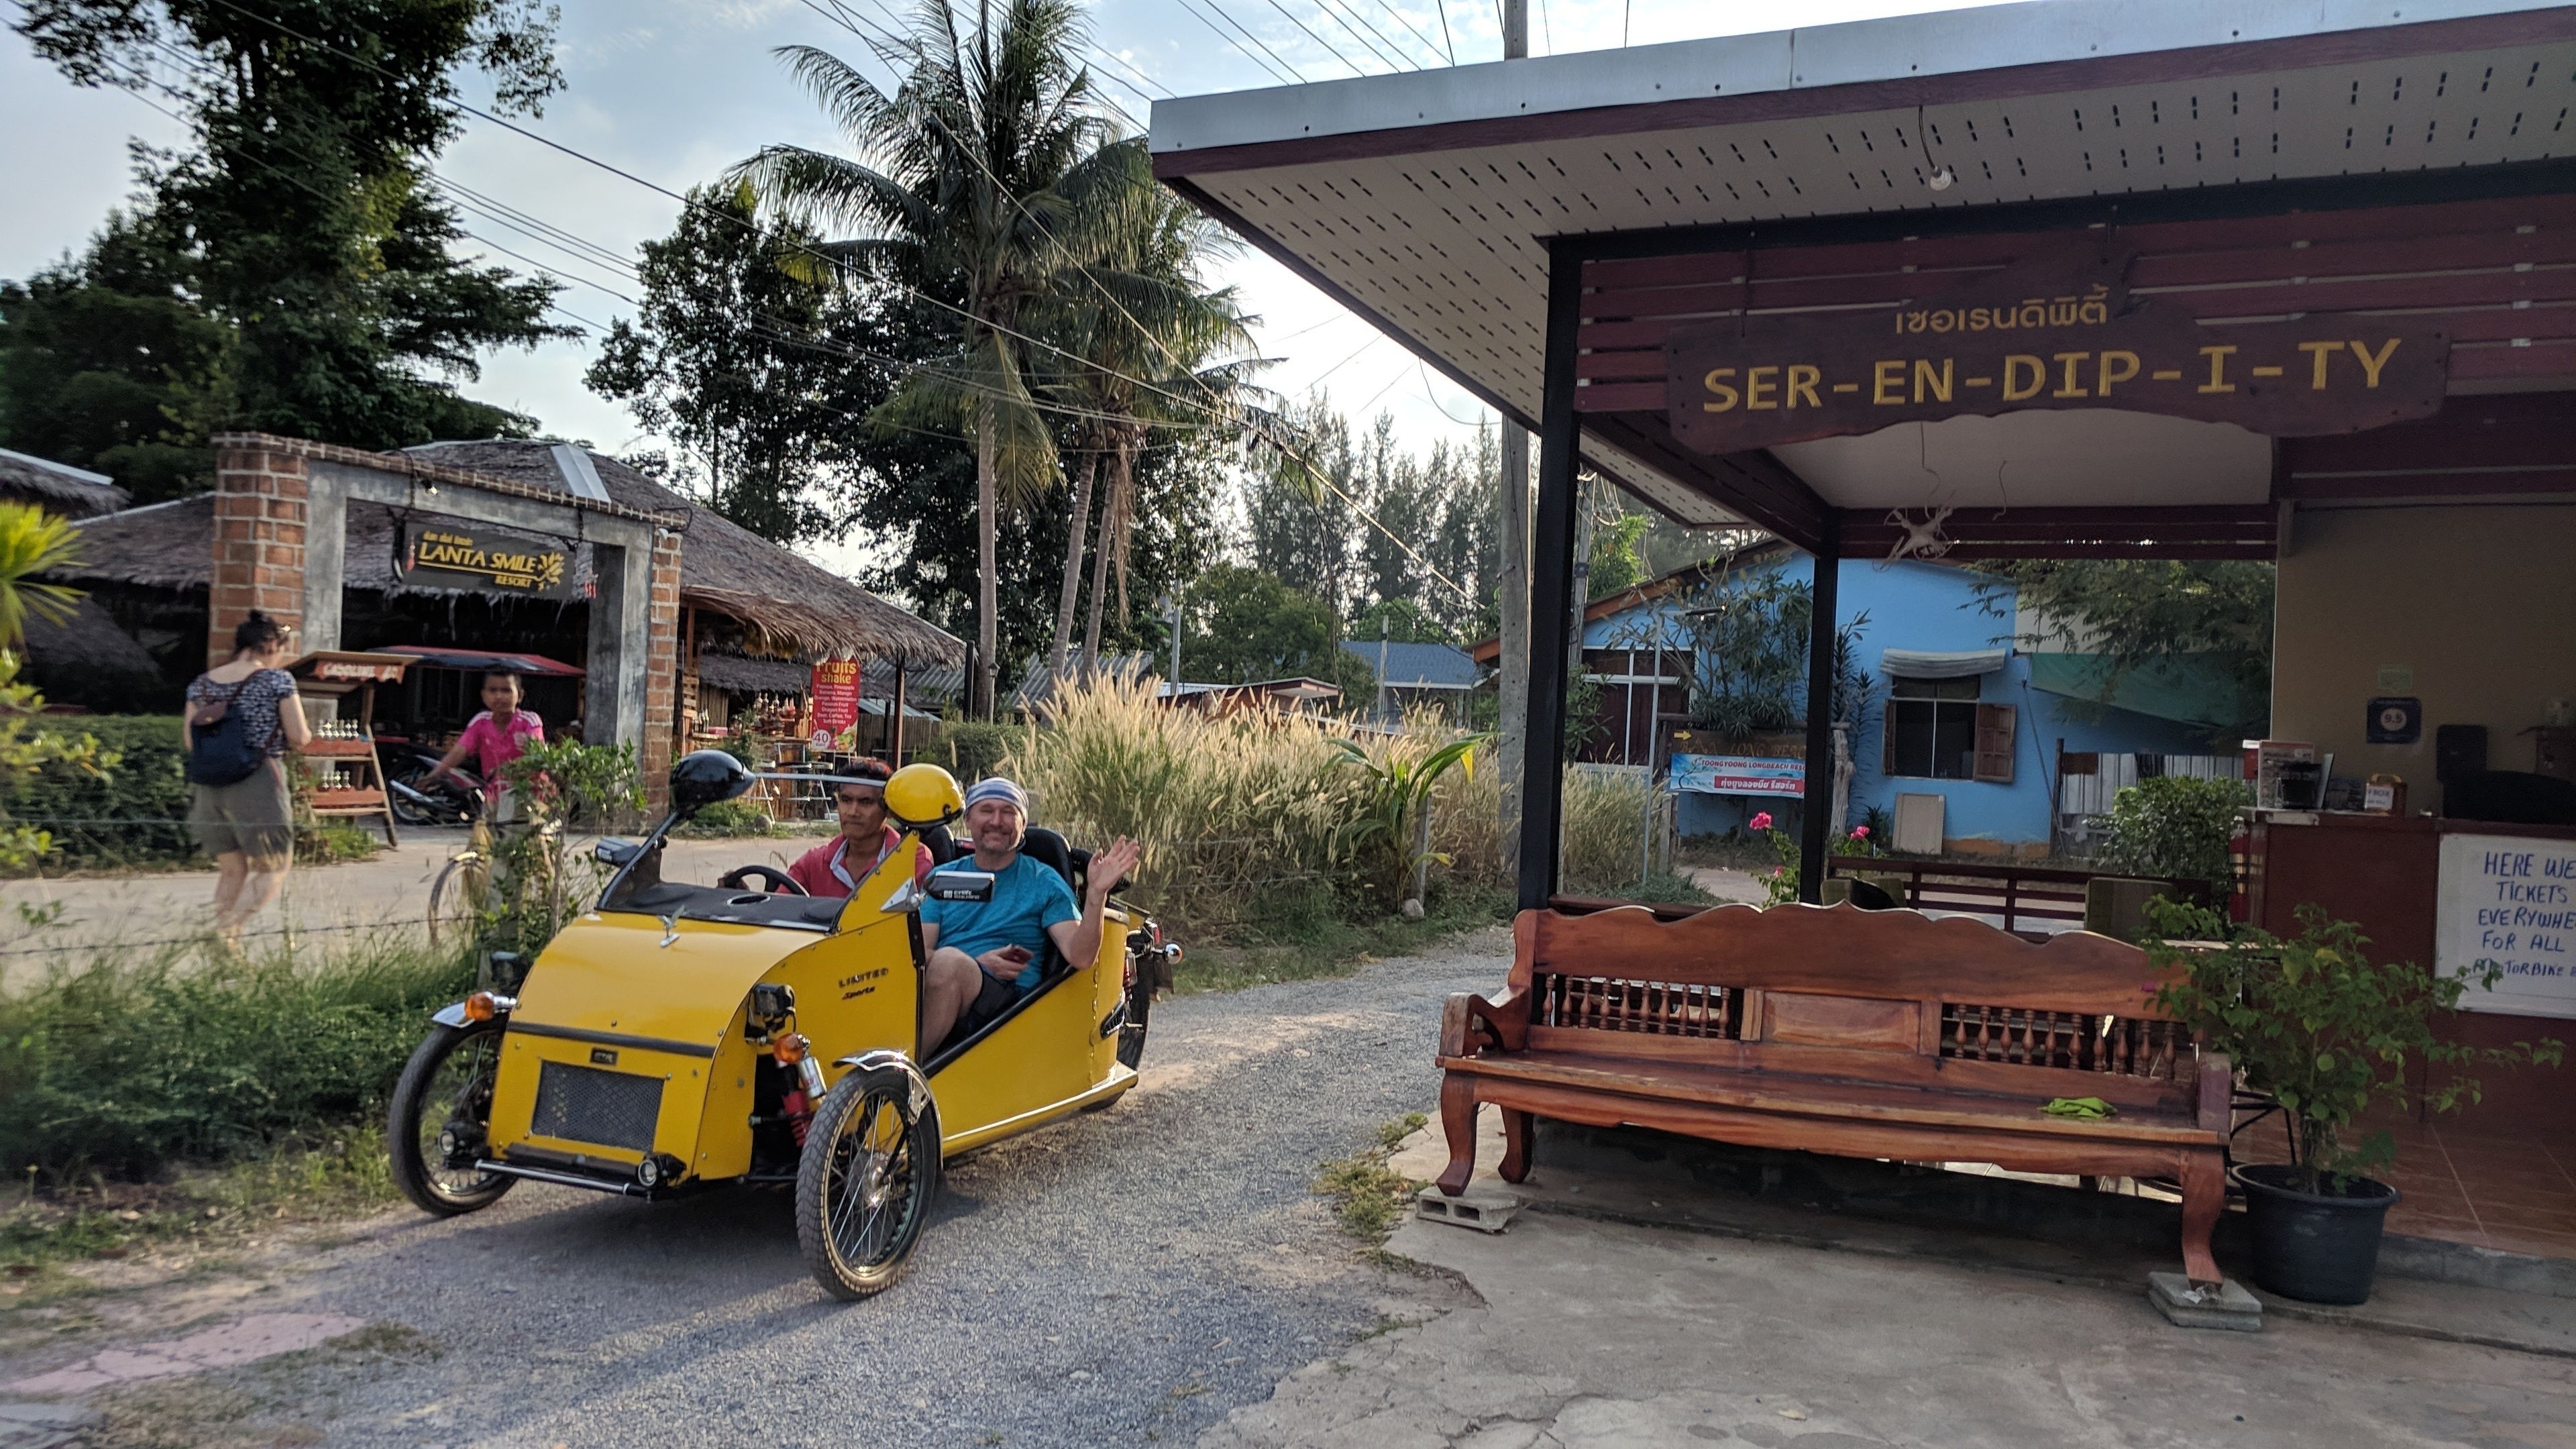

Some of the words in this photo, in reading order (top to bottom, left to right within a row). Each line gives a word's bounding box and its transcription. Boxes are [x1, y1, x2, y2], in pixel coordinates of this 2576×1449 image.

[419, 541, 486, 567] LANTA
[490, 553, 537, 573] SMILE
[494, 575, 532, 588] RESORT
[820, 672, 851, 684] shake
[814, 733, 828, 743] 40
[1729, 742, 1764, 757] LONG
[2484, 851, 2534, 877] HERE
[2544, 857, 2576, 879] WE
[2497, 881, 2567, 904] TICKETS
[2478, 906, 2576, 929] EVERYWHE
[2483, 930, 2516, 951] FOR
[2530, 934, 2565, 952] ALL
[839, 967, 888, 987] LIMITED
[2473, 957, 2564, 977] MTORBIKE
[842, 986, 875, 1000] Sports
